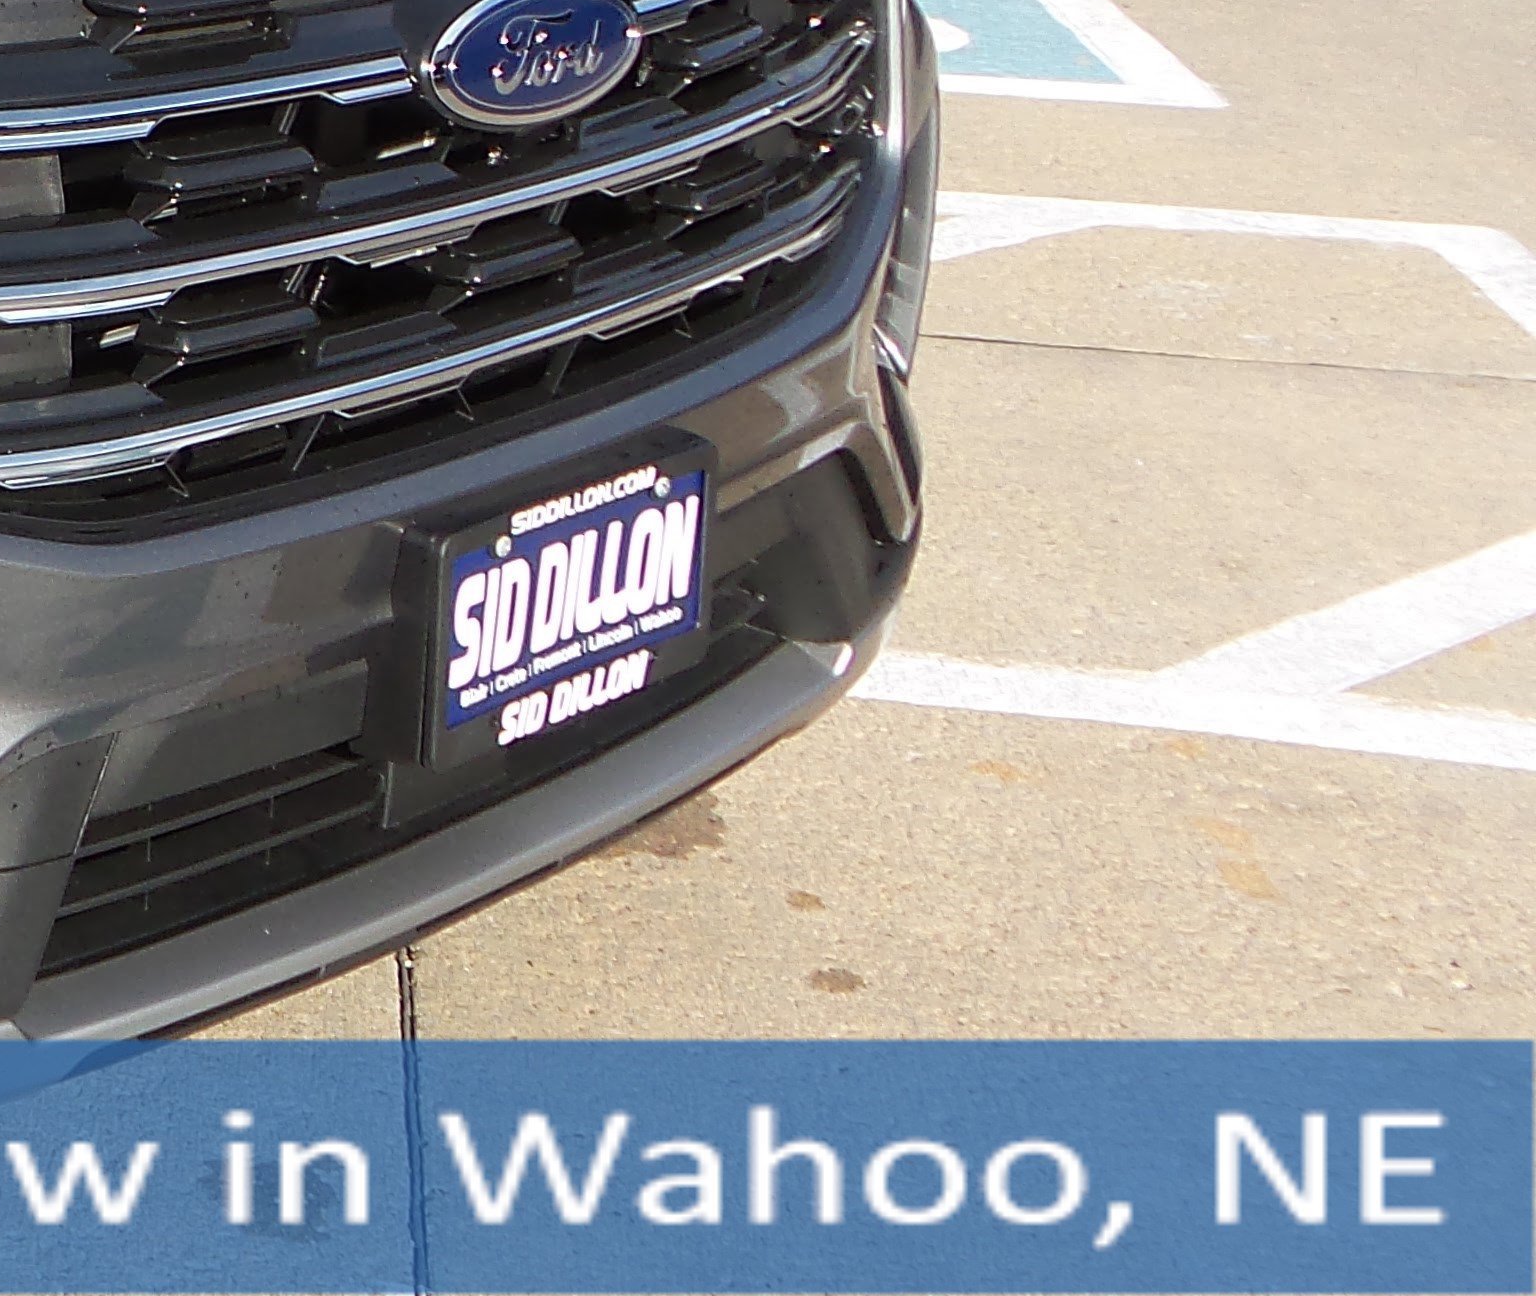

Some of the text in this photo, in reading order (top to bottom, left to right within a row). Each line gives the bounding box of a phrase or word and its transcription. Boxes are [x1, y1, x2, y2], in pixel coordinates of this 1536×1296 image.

[493, 8, 604, 95] Ford
[510, 465, 657, 536] SIDDILLON.COM
[447, 494, 699, 690] SID DILLON
[497, 648, 651, 746] SID DILLON
